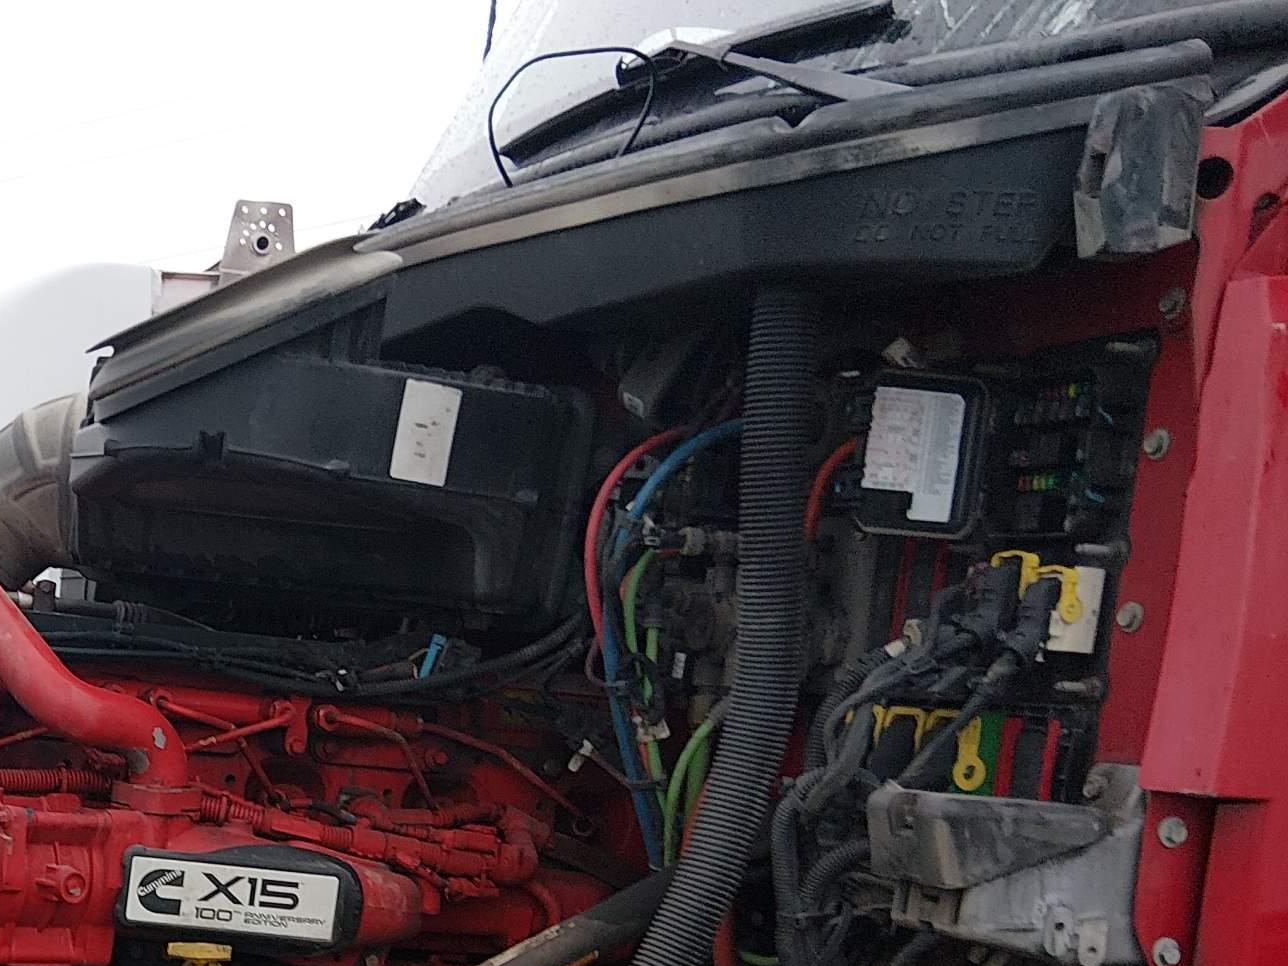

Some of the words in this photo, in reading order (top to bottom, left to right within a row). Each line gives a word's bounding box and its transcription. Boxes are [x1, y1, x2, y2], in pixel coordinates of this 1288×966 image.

[198, 872, 300, 910] X15
[244, 911, 326, 927] ANNIVERSARY
[244, 918, 289, 929] EDITION
